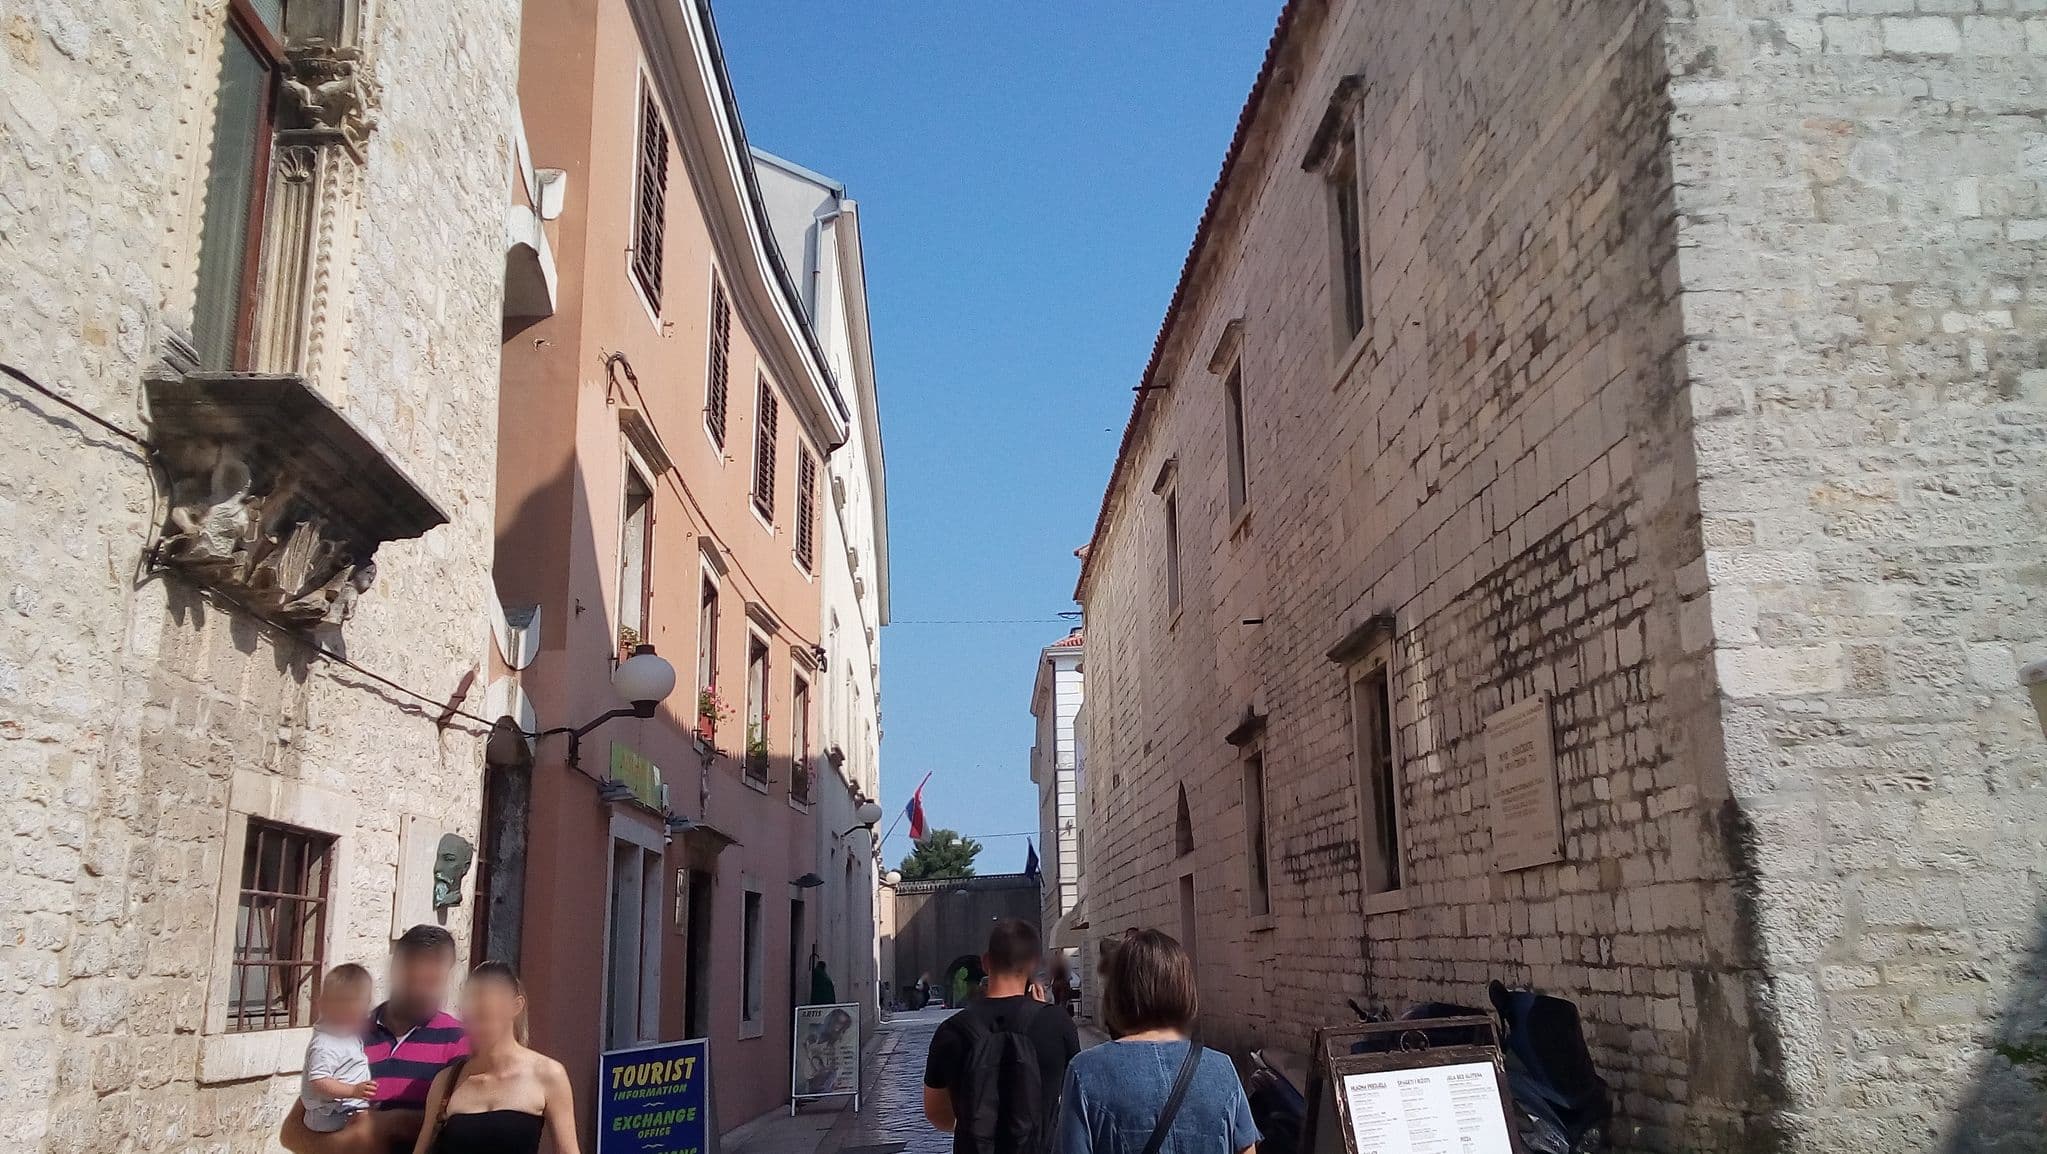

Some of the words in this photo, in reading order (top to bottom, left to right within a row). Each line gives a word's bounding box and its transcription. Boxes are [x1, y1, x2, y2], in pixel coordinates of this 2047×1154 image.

[612, 1057, 696, 1089] TOURIST
[614, 1083, 688, 1101] INFORMATION
[613, 1107, 696, 1131] EXCHANGE
[638, 1127, 672, 1139] OFFICE
